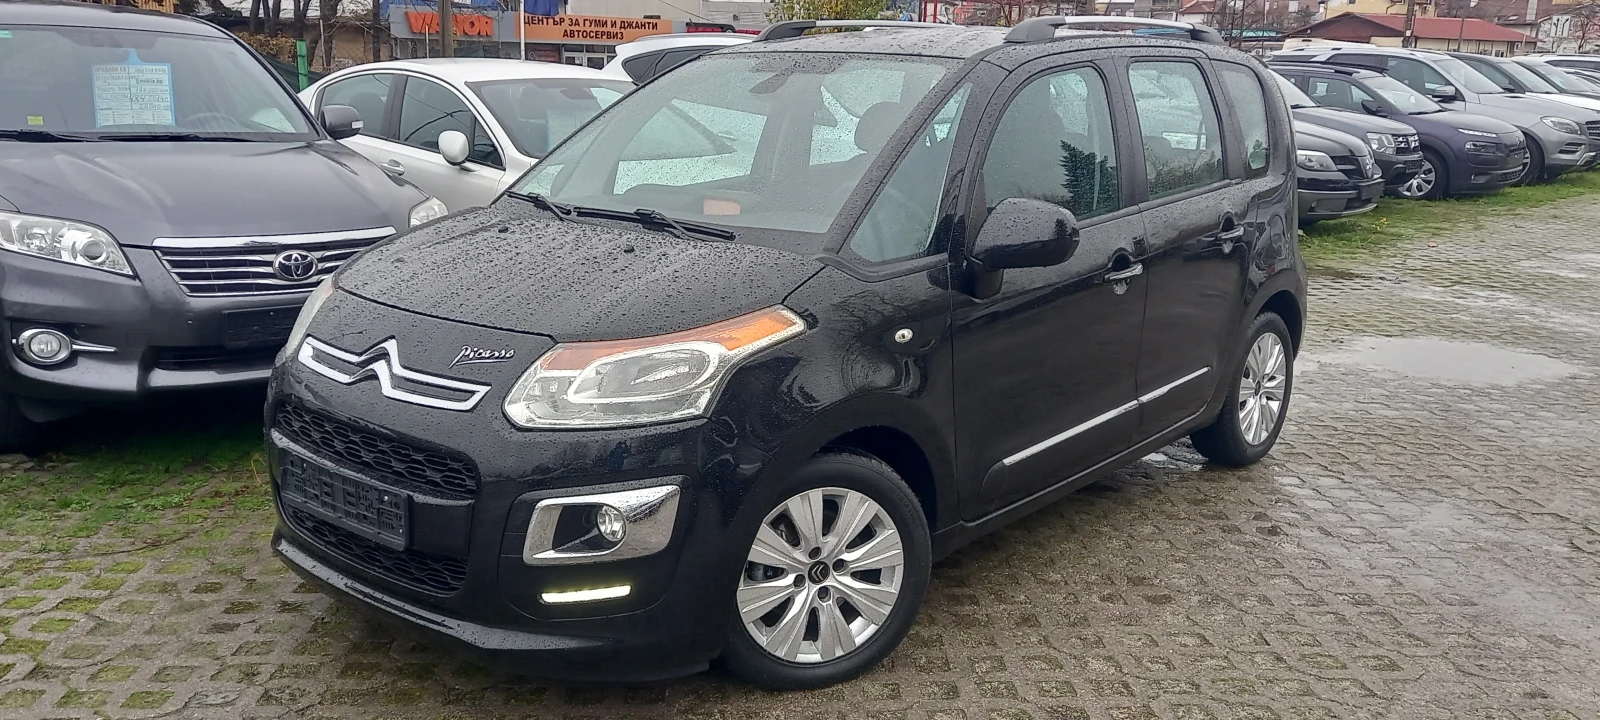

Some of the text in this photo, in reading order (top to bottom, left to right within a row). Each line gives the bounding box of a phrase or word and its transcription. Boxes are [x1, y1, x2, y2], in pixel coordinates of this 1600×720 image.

[524, 15, 658, 30] ЦЕНТЪР ЗА ГУМИ И ДЖАНТИ
[562, 29, 624, 40] АВТОСЕРВИЗ
[448, 345, 516, 369] Picasso
